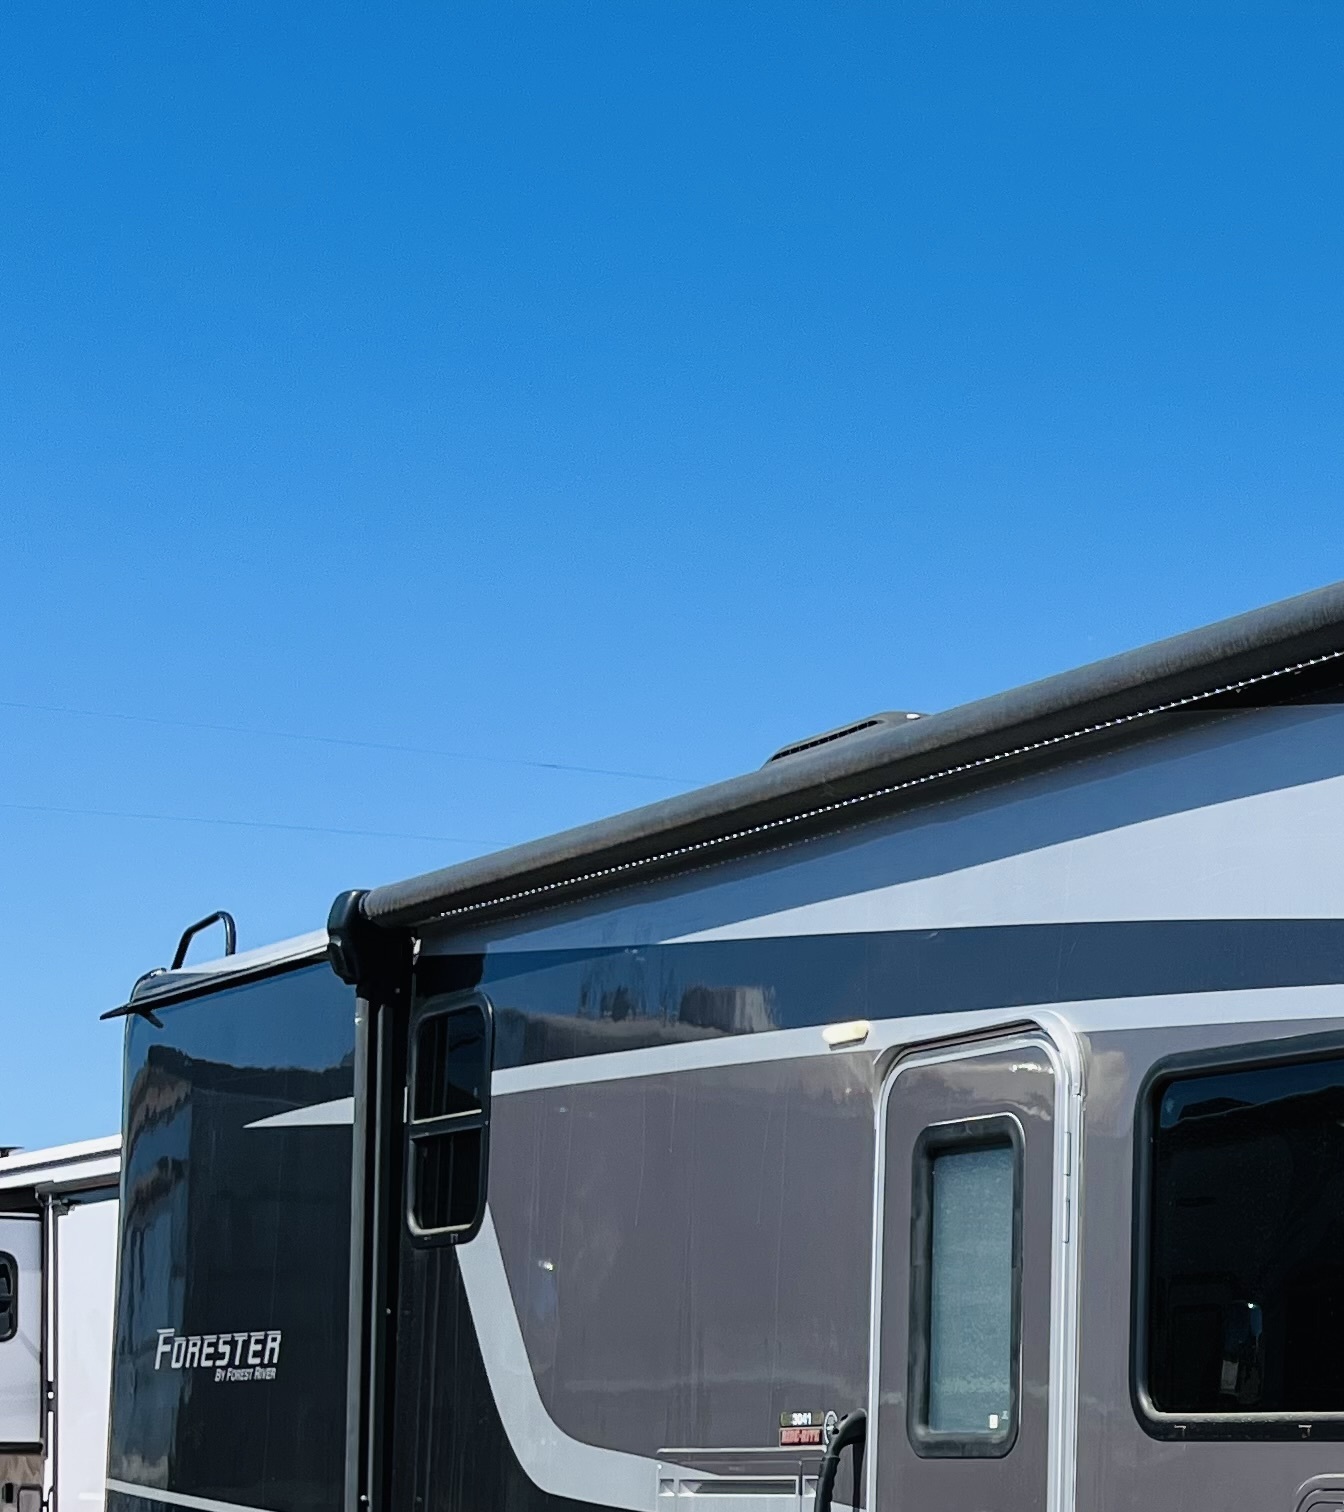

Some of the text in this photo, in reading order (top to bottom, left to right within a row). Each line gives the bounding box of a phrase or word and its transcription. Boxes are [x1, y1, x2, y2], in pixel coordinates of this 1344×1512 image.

[154, 1328, 281, 1370] FORESTER
[215, 1366, 276, 1382] BY FOREST RIVER
